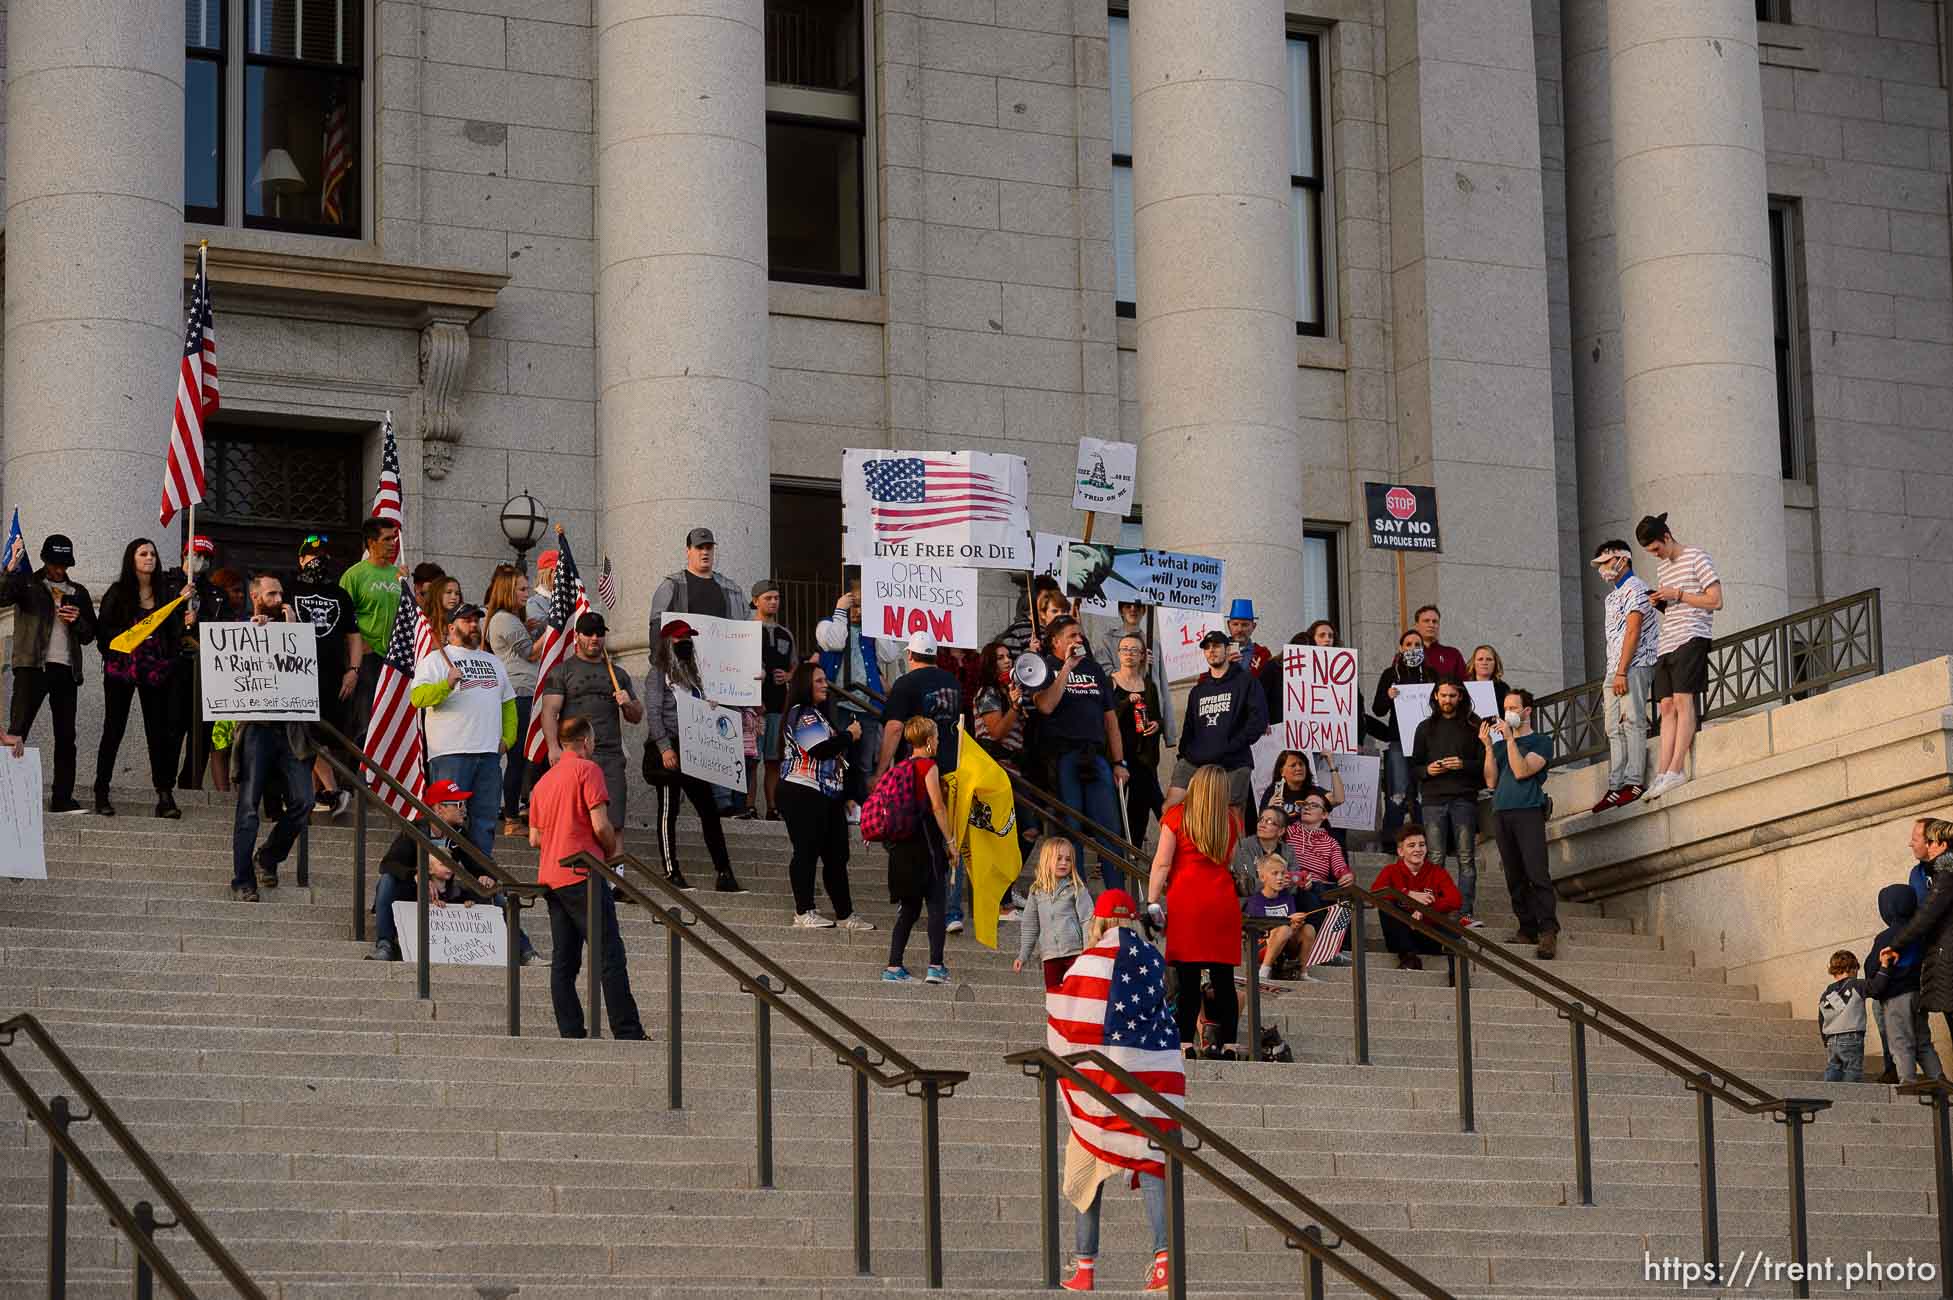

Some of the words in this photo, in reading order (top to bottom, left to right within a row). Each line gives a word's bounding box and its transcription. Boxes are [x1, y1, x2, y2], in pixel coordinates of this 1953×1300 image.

[1387, 496, 1414, 510] STOP
[1375, 518, 1404, 533] SAY
[1407, 521, 1431, 534] NO
[874, 541, 909, 557] LIVE
[916, 542, 954, 558] FREE
[960, 544, 983, 559] OR
[989, 543, 1015, 560] DIE
[1372, 534, 1383, 545] TO
[1383, 535, 1389, 545] A
[1389, 535, 1412, 546] POLICE
[1413, 537, 1437, 548] STATE
[891, 561, 943, 584] OPEN
[1140, 553, 1154, 567] At
[1158, 555, 1188, 571] what
[1192, 560, 1219, 576] point
[1152, 571, 1173, 586] will
[1175, 576, 1198, 590] you
[1201, 579, 1217, 592] say
[876, 580, 964, 608] BUSINESSES
[883, 604, 954, 643] NOW
[210, 626, 270, 654] UTAH
[281, 631, 298, 655] IS
[214, 654, 224, 673] A
[454, 659, 468, 669] MY
[470, 659, 494, 669] FAITH
[1286, 680, 1353, 717] NEW
[1286, 719, 1358, 754] NORMAL
